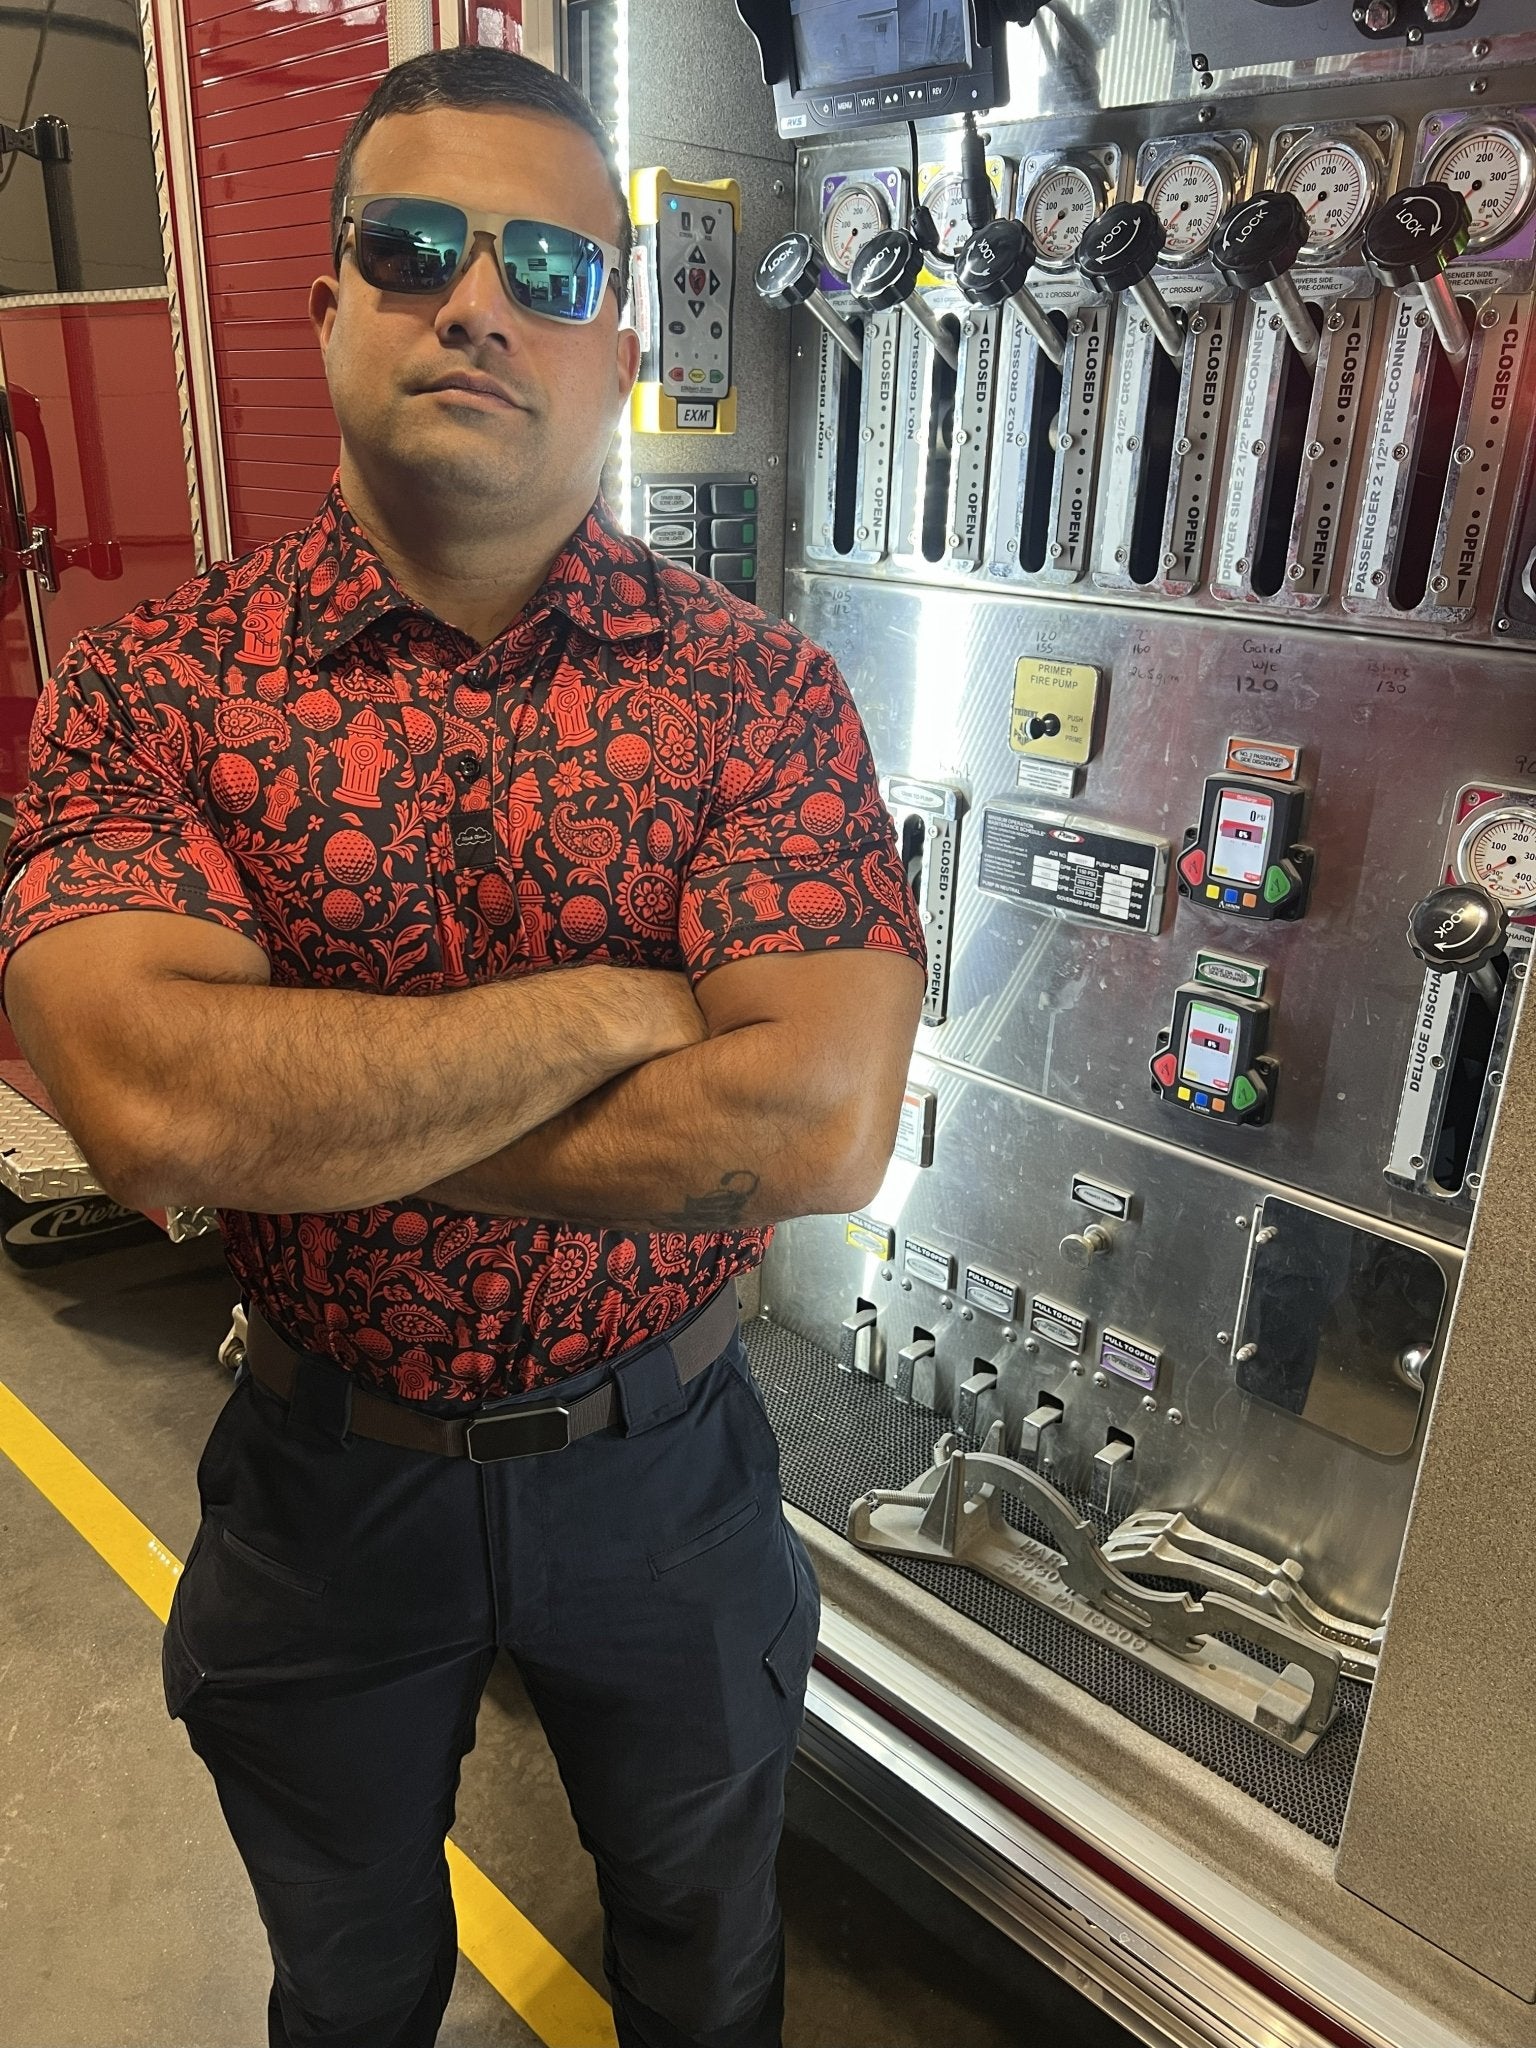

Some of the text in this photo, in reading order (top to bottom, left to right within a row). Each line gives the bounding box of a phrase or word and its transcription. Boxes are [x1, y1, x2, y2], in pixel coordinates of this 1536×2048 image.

[932, 87, 942, 96] REV
[837, 102, 852, 110] MENU
[1475, 152, 1494, 163] 200
[1320, 165, 1337, 176] 200
[1453, 170, 1471, 181] 100
[1489, 171, 1508, 182] 300
[1183, 177, 1198, 187] 200
[1302, 182, 1317, 193] 100
[1333, 183, 1349, 193] 300
[1060, 187, 1074, 196] 200
[1166, 193, 1180, 202] 100
[1194, 194, 1209, 203] 300
[1480, 198, 1499, 209] 400
[1045, 202, 1058, 211] 100
[1071, 203, 1084, 212] 300
[1326, 208, 1342, 219] 400
[1188, 219, 1203, 228] 400
[1235, 208, 1269, 243] LOCK
[1395, 208, 1426, 238] LOCK
[1065, 227, 1079, 235] 400
[1096, 219, 1128, 252] LOCK
[977, 238, 996, 264] LOCK
[768, 246, 795, 273] LOCK
[1476, 270, 1493, 278] SIDE
[1297, 283, 1343, 291] PRE-CONNECT
[1450, 278, 1499, 286] PRE-CONNECT
[1049, 291, 1080, 299] CROSSLAY
[1169, 285, 1203, 294] CROSSLAY
[909, 323, 921, 401] CROSSLAY
[1008, 318, 1023, 402] CROSSLAY
[1120, 315, 1138, 405] CROSSLAY
[879, 339, 893, 401] CLOSED
[976, 337, 990, 403] CLOSED
[1082, 338, 1100, 405] CLOSED
[1201, 334, 1223, 407] CLOSED
[1243, 306, 1267, 430] PRE-CONNECT
[1336, 332, 1363, 411] CLOSED
[1489, 328, 1520, 411] CLOSED
[684, 409, 709, 422] EXM
[818, 413, 826, 459] FRONT
[1355, 494, 1381, 593] PASSENGER
[1374, 475, 1384, 488] 2
[1381, 302, 1413, 435] PRE-CONNECT
[1236, 467, 1246, 477] 2
[1229, 480, 1244, 517] SIDE
[873, 486, 884, 528] OPEN
[965, 492, 979, 536] OPEN
[1067, 498, 1083, 543] OPEN
[1183, 506, 1201, 554] OPEN
[1311, 516, 1333, 566] OPEN
[1221, 521, 1238, 581] DRIVER
[1457, 523, 1482, 577] OPEN
[1036, 631, 1057, 642] 120
[1242, 639, 1282, 654] Gated
[1038, 663, 1073, 677] PRIMER
[1030, 675, 1078, 690] FIRE PUMP
[1236, 676, 1279, 694] 120
[1375, 680, 1407, 694] 130
[1014, 707, 1039, 718] TRIDENT
[1067, 714, 1084, 723] PUSH
[1070, 725, 1079, 733] TO
[1065, 734, 1083, 744] PRIME
[1251, 758, 1282, 769] DISCHARGE
[1252, 753, 1284, 764] PASSENGER
[1249, 810, 1257, 822] 0
[1512, 832, 1529, 843] 200
[1490, 841, 1507, 852] 100
[938, 839, 953, 893] CLOSED
[1095, 860, 1110, 869] PUMP
[1486, 863, 1492, 872] 0
[1514, 871, 1532, 883] 400
[1082, 901, 1100, 910] SPEED
[1434, 907, 1465, 939] LOCK
[931, 962, 942, 998] OPEN
[1217, 1022, 1225, 1034] 0
[1409, 971, 1443, 1093] DELUGE DISCHA
[906, 1241, 948, 1265] PULL TO OPEN
[968, 1271, 1013, 1296] PULL TO OPEN
[1034, 1301, 1082, 1328] PULL TO OPEN
[1104, 1334, 1155, 1364] PULL TO OPEN
[1053, 1592, 1075, 1615] PA
